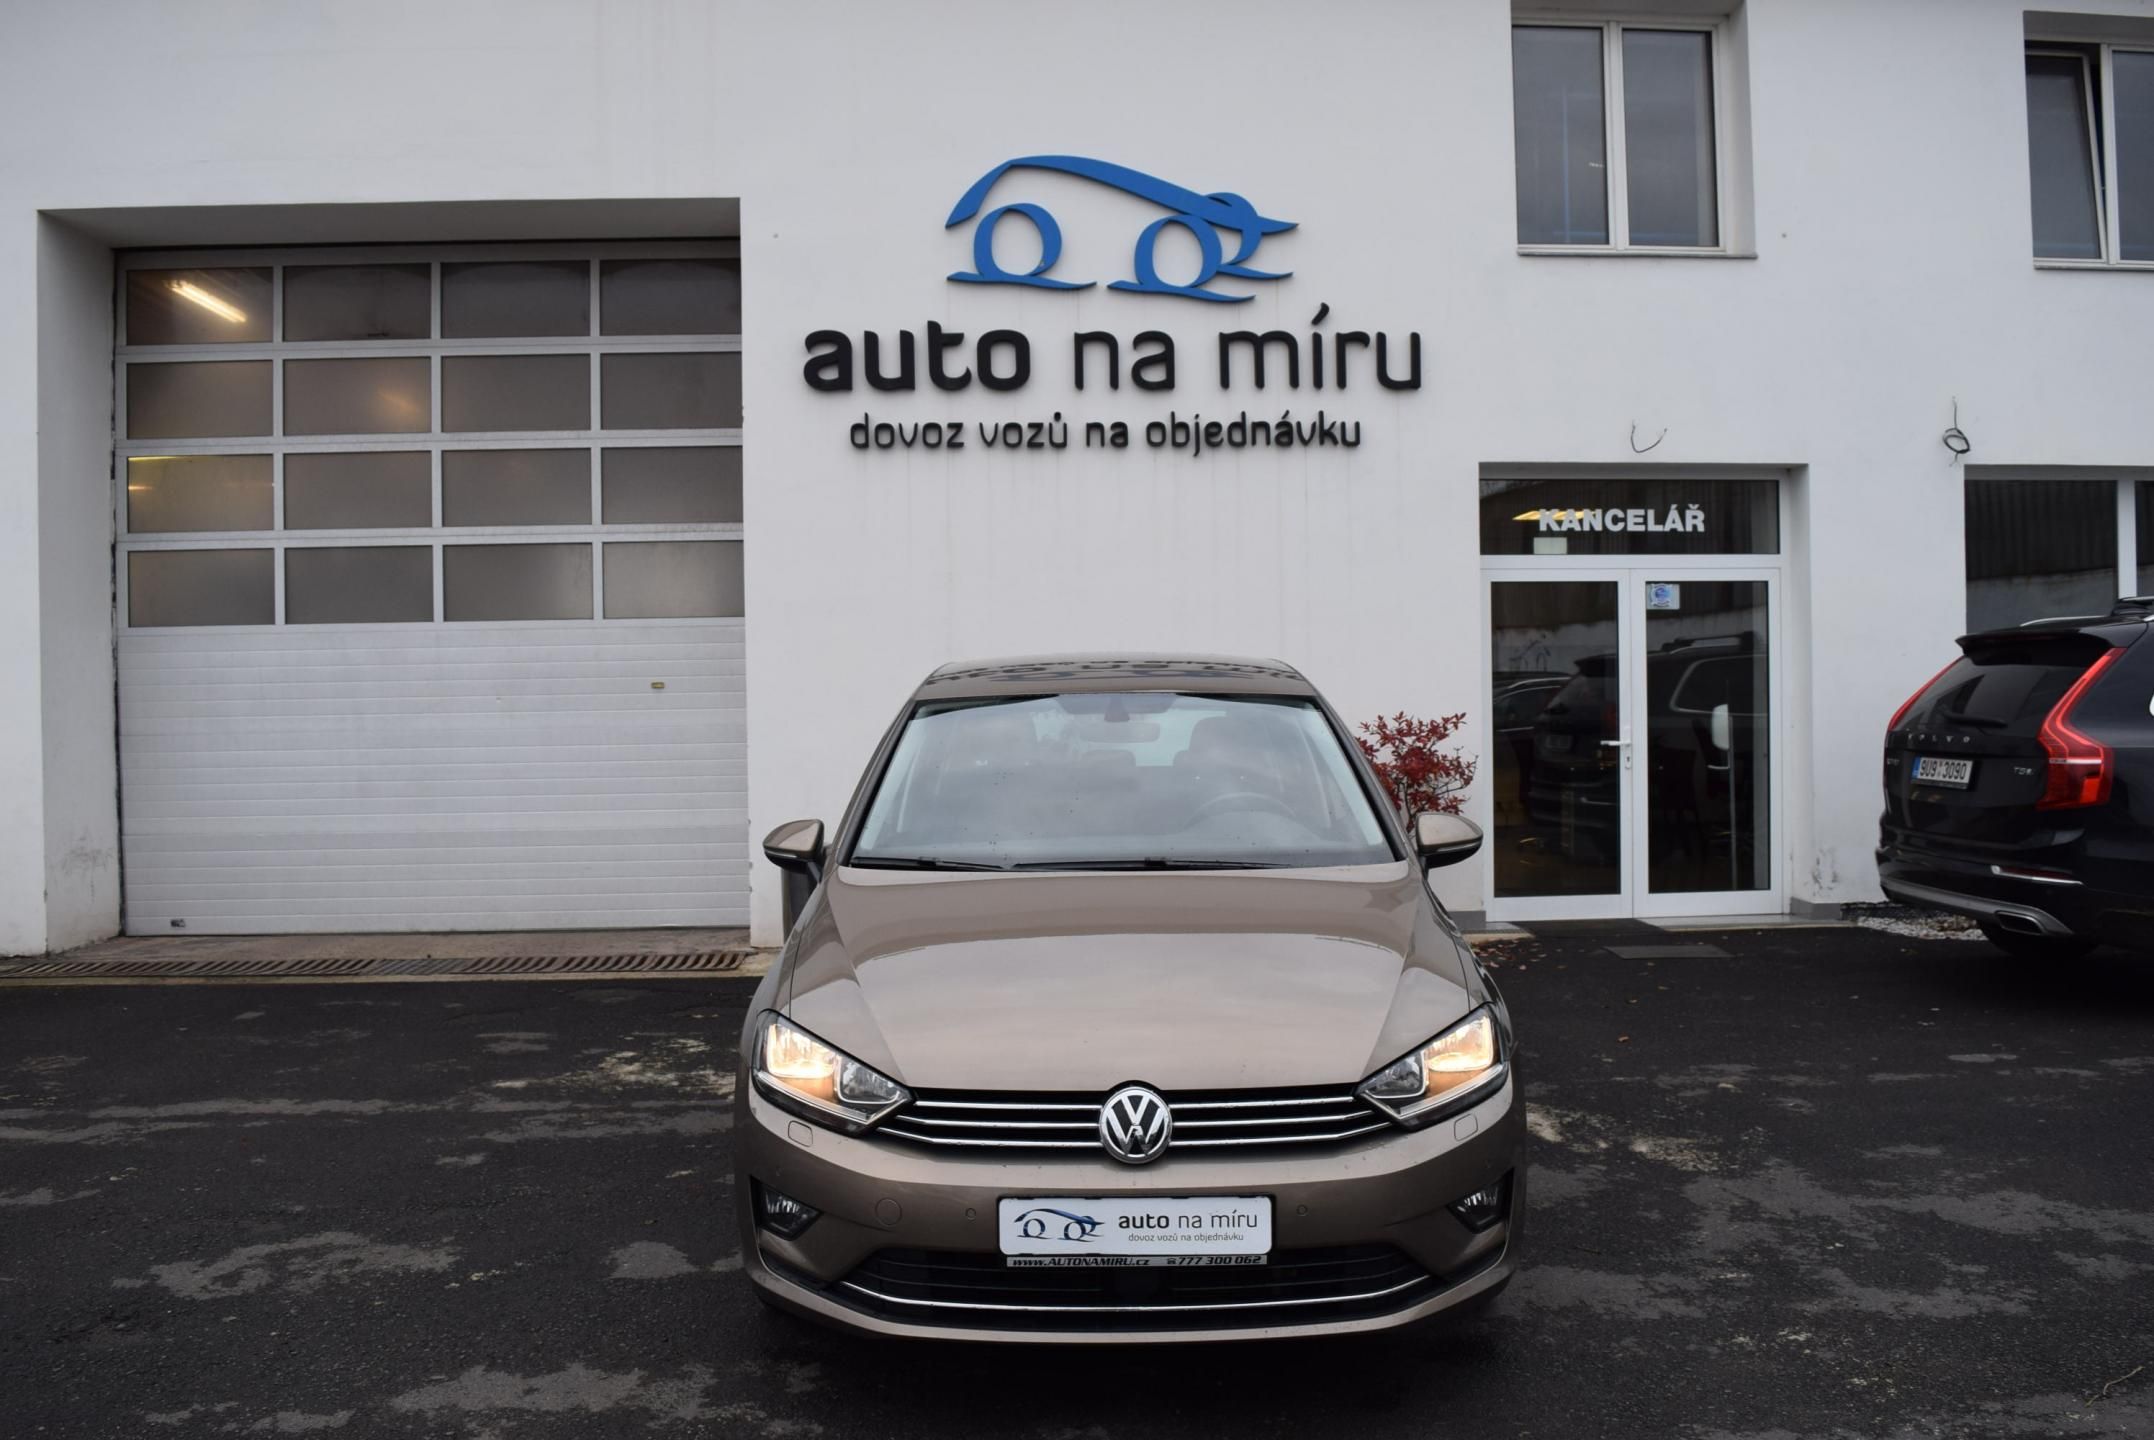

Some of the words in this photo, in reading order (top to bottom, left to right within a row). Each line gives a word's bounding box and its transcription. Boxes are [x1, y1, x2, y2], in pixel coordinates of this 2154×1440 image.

[803, 320, 1030, 392] auto
[1074, 330, 1176, 392] na
[1219, 302, 1422, 392] míru
[850, 412, 965, 450] dovoz
[979, 411, 1068, 450] vozů
[1085, 421, 1129, 450] na
[1145, 410, 1361, 458] objednávku
[1539, 503, 1705, 533] KANCELÁŘ
[1942, 762, 1967, 780] 3090
[1118, 1212, 1170, 1229] auto
[1178, 1214, 1202, 1229] na
[1211, 1209, 1258, 1229] míru
[1128, 1232, 1155, 1242] dovoz
[1180, 1234, 1192, 1242] na
[1194, 1232, 1244, 1244] objednávku
[1206, 1256, 1232, 1265] 300
[1234, 1255, 1262, 1264] 062
